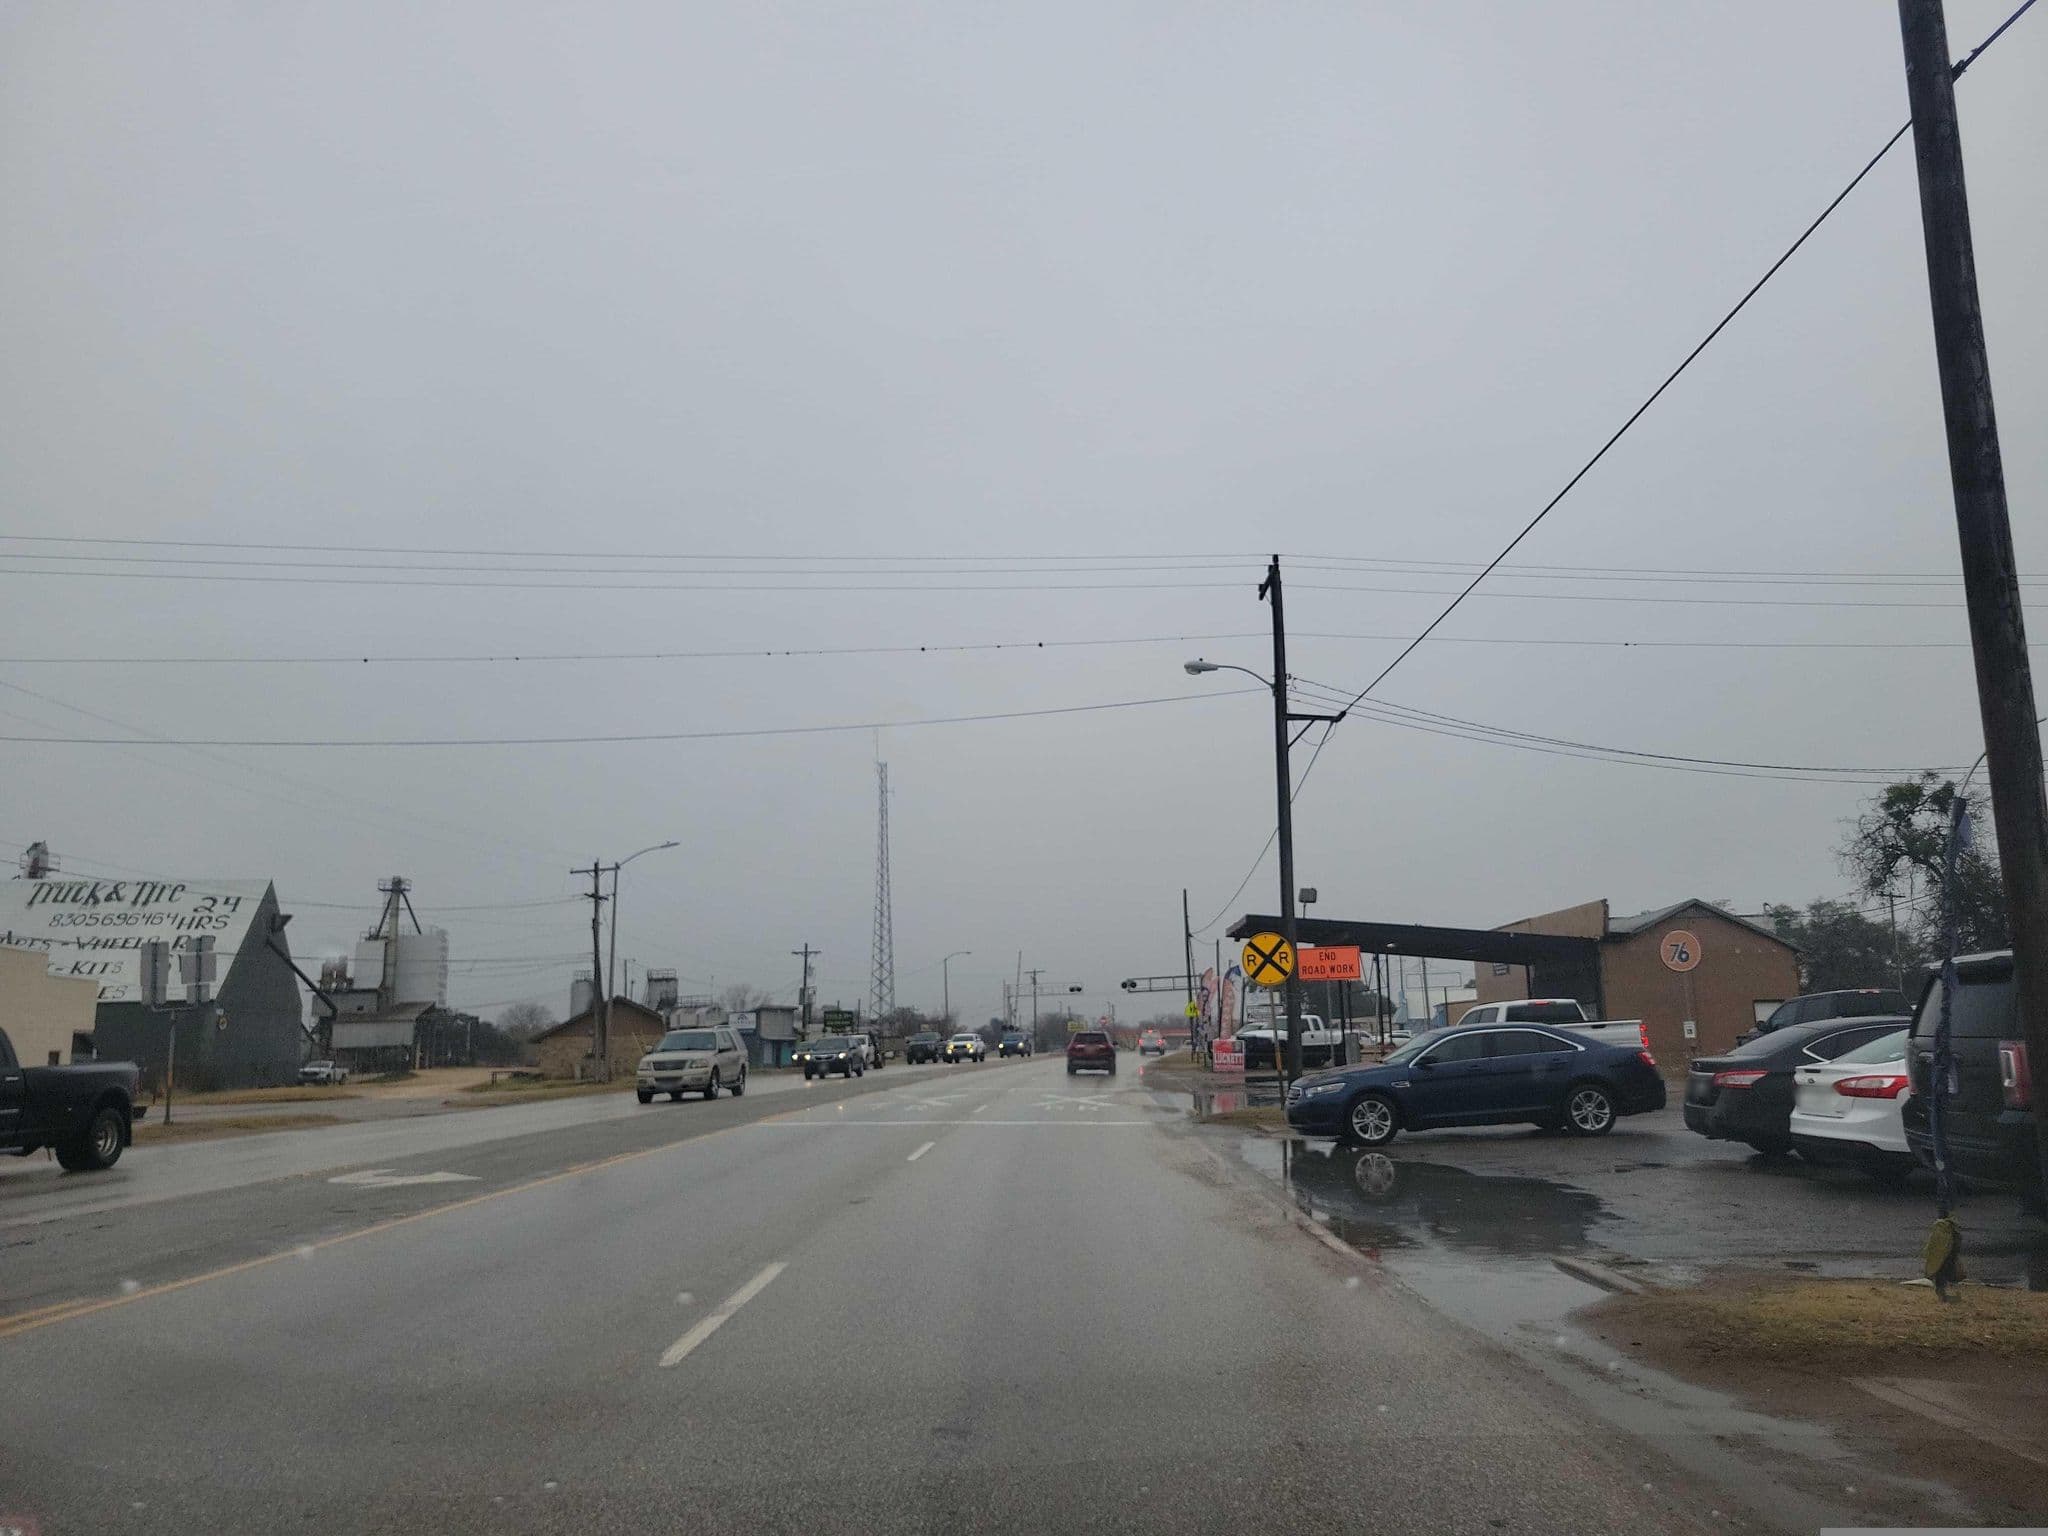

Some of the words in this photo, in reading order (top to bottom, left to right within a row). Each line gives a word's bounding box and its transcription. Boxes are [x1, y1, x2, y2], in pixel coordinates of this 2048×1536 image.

[193, 896, 243, 913] 24
[176, 915, 231, 930] HRS
[1318, 951, 1337, 961] END
[1668, 942, 1690, 963] 76
[1301, 965, 1326, 975] ROAD
[1328, 964, 1355, 974] WORK
